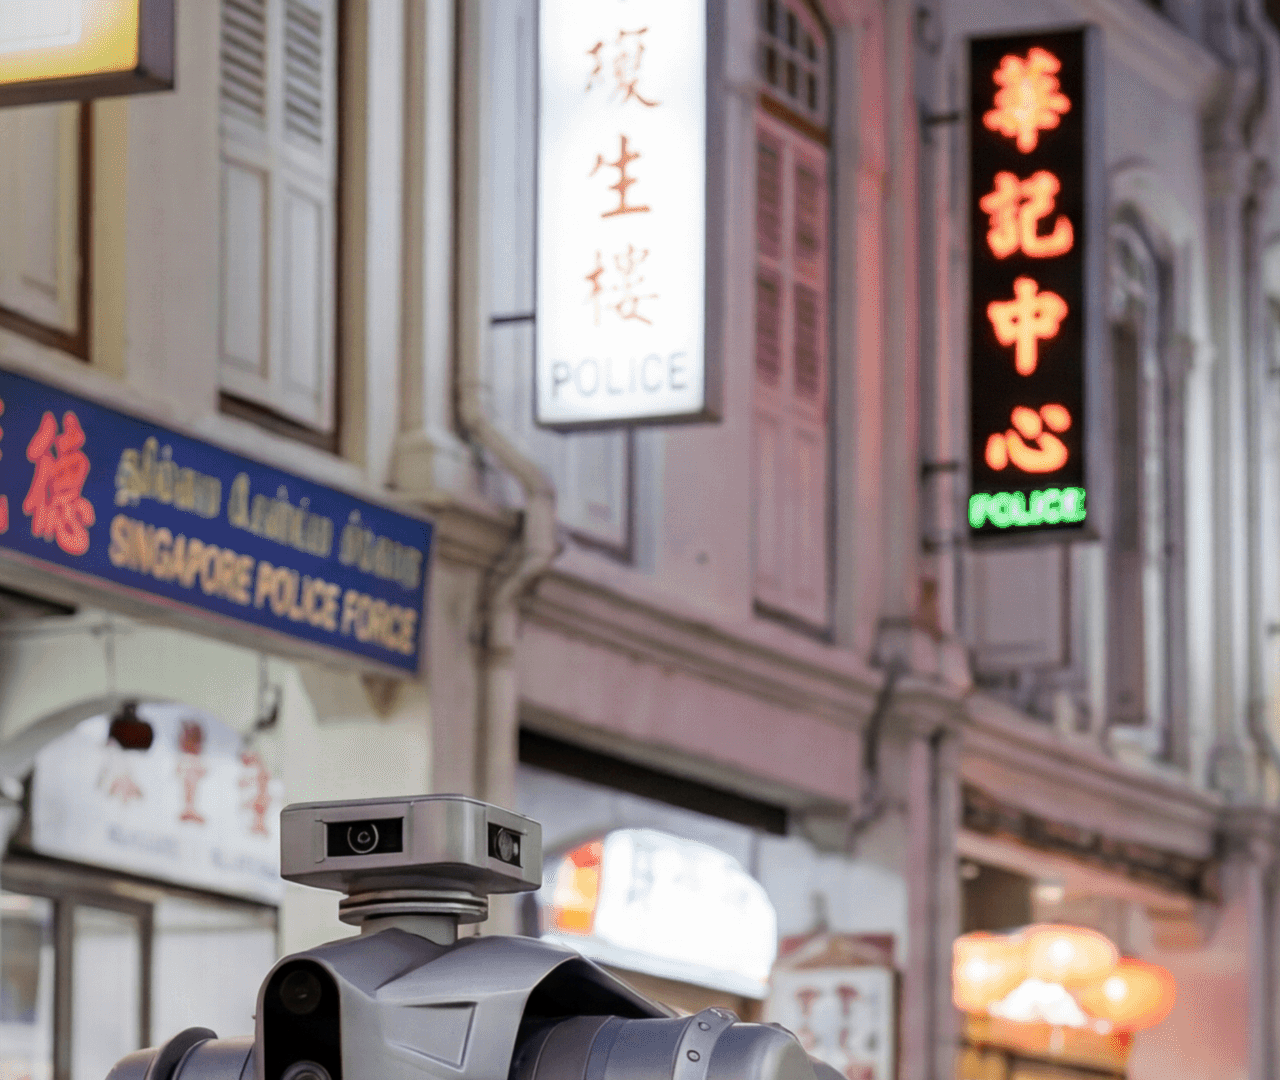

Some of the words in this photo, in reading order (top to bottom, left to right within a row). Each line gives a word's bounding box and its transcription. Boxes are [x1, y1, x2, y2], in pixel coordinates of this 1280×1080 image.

[550, 350, 689, 400] POLICE
[968, 487, 1087, 529] POLICE
[109, 514, 255, 606] SINGAPORE
[254, 560, 341, 632] POLICE
[340, 589, 417, 656] FORCE
